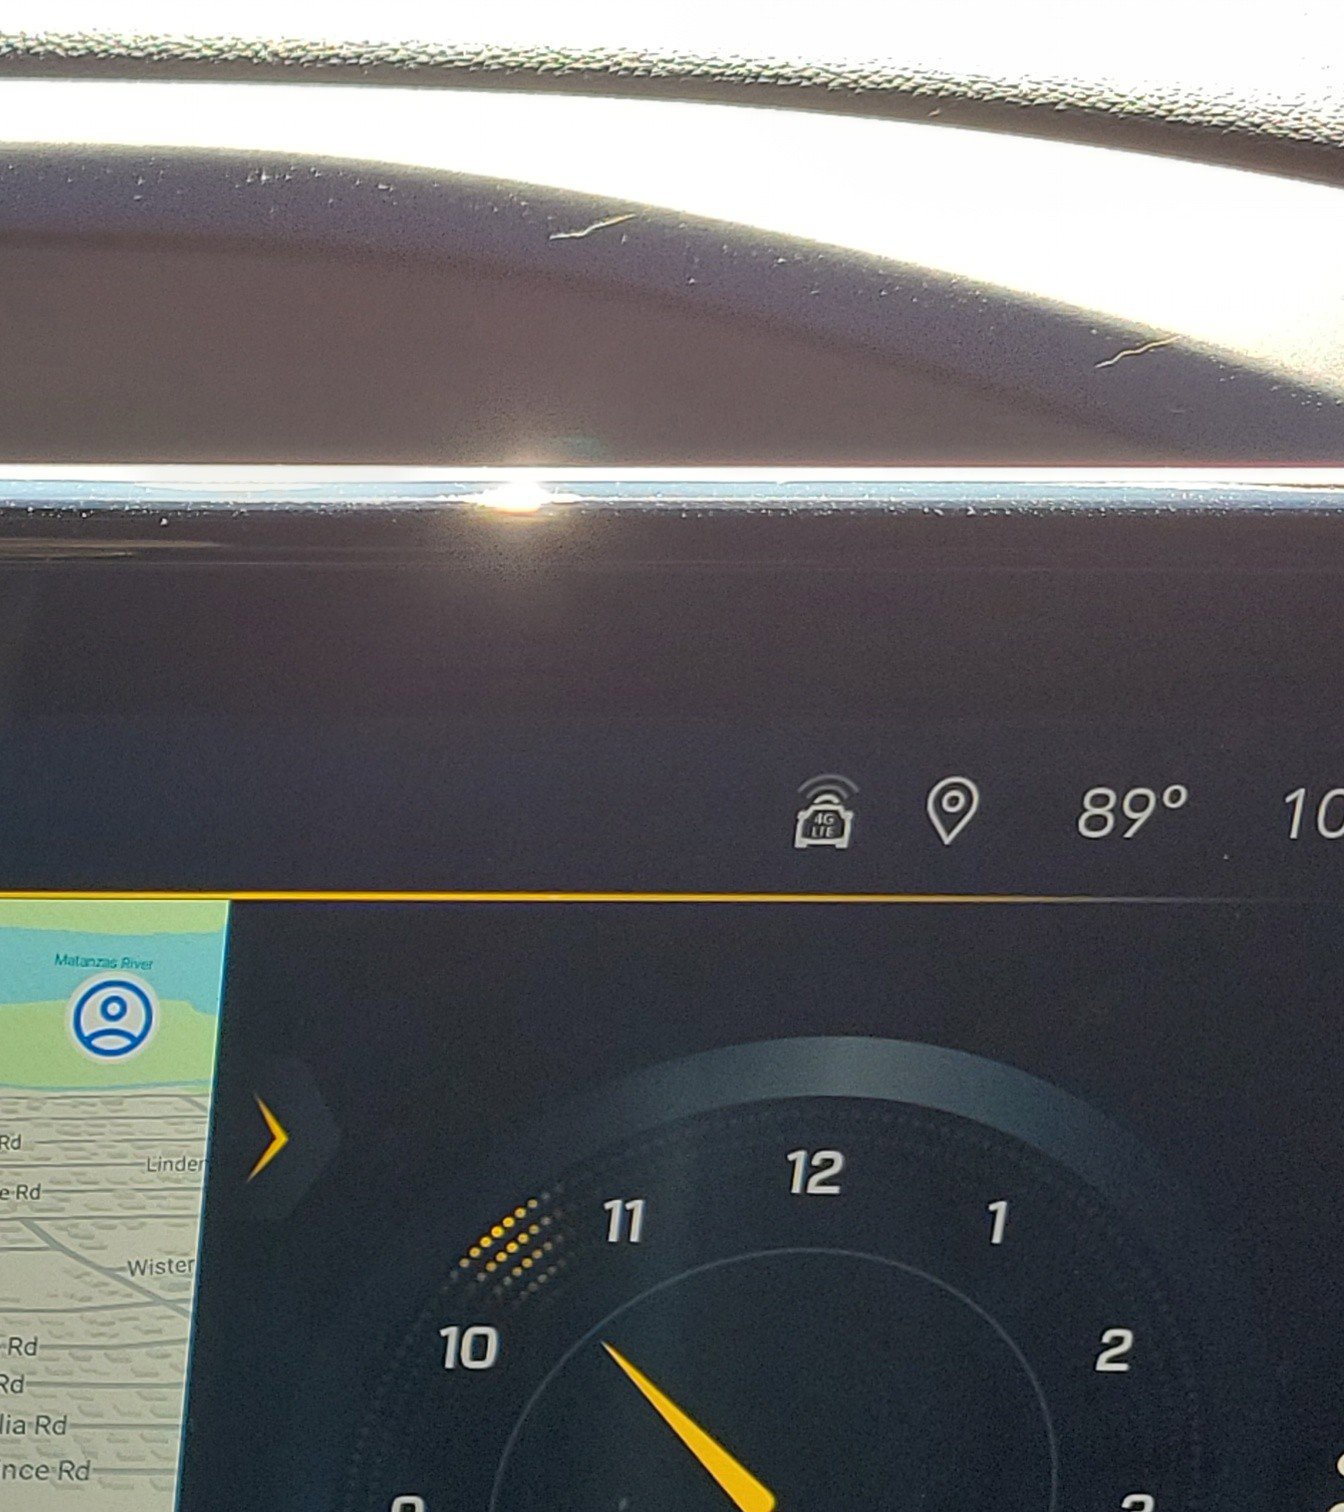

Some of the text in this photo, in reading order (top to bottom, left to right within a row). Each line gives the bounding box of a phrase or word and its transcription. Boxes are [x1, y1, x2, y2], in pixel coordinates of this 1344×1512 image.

[814, 812, 834, 825] 4G
[1284, 787, 1344, 839] 10
[811, 826, 834, 837] LTE
[55, 953, 154, 971] Matanzas River
[787, 1149, 845, 1195] 12
[15, 1183, 41, 1201] Rd
[603, 1198, 646, 1243] 11
[987, 1200, 1009, 1245] 1
[7, 1336, 38, 1357] Rd
[439, 1325, 500, 1370] 10
[1096, 1328, 1135, 1372] 2
[35, 1414, 67, 1436] Rd
[54, 1459, 91, 1482] Rd
